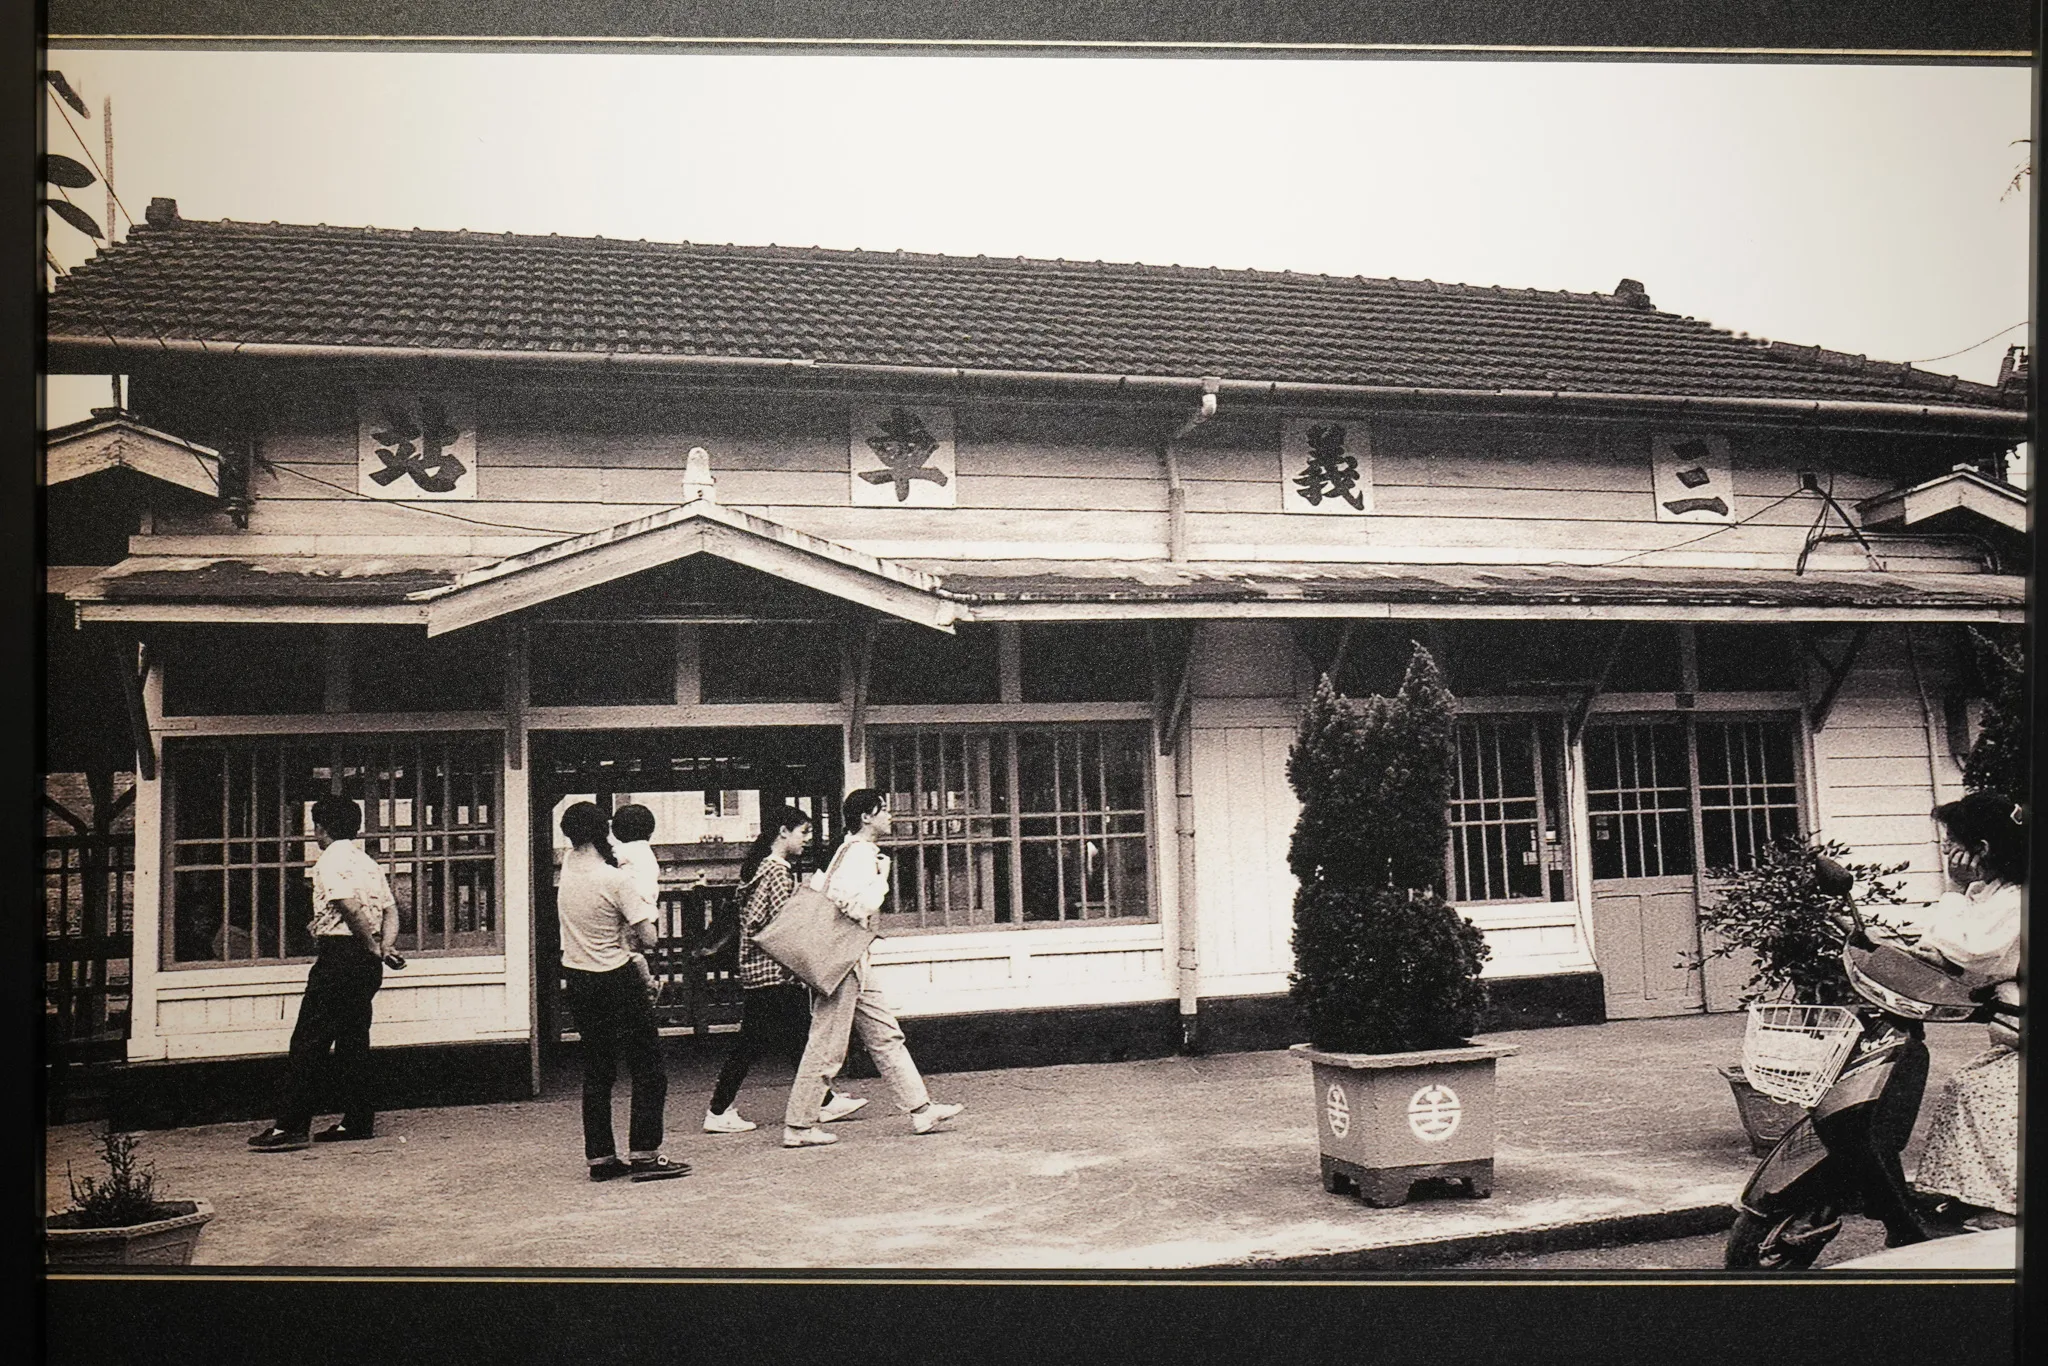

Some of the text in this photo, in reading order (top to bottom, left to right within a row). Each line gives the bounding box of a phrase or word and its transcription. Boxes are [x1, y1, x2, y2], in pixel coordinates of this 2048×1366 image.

[367, 396, 1730, 518] 三 義 車 站
